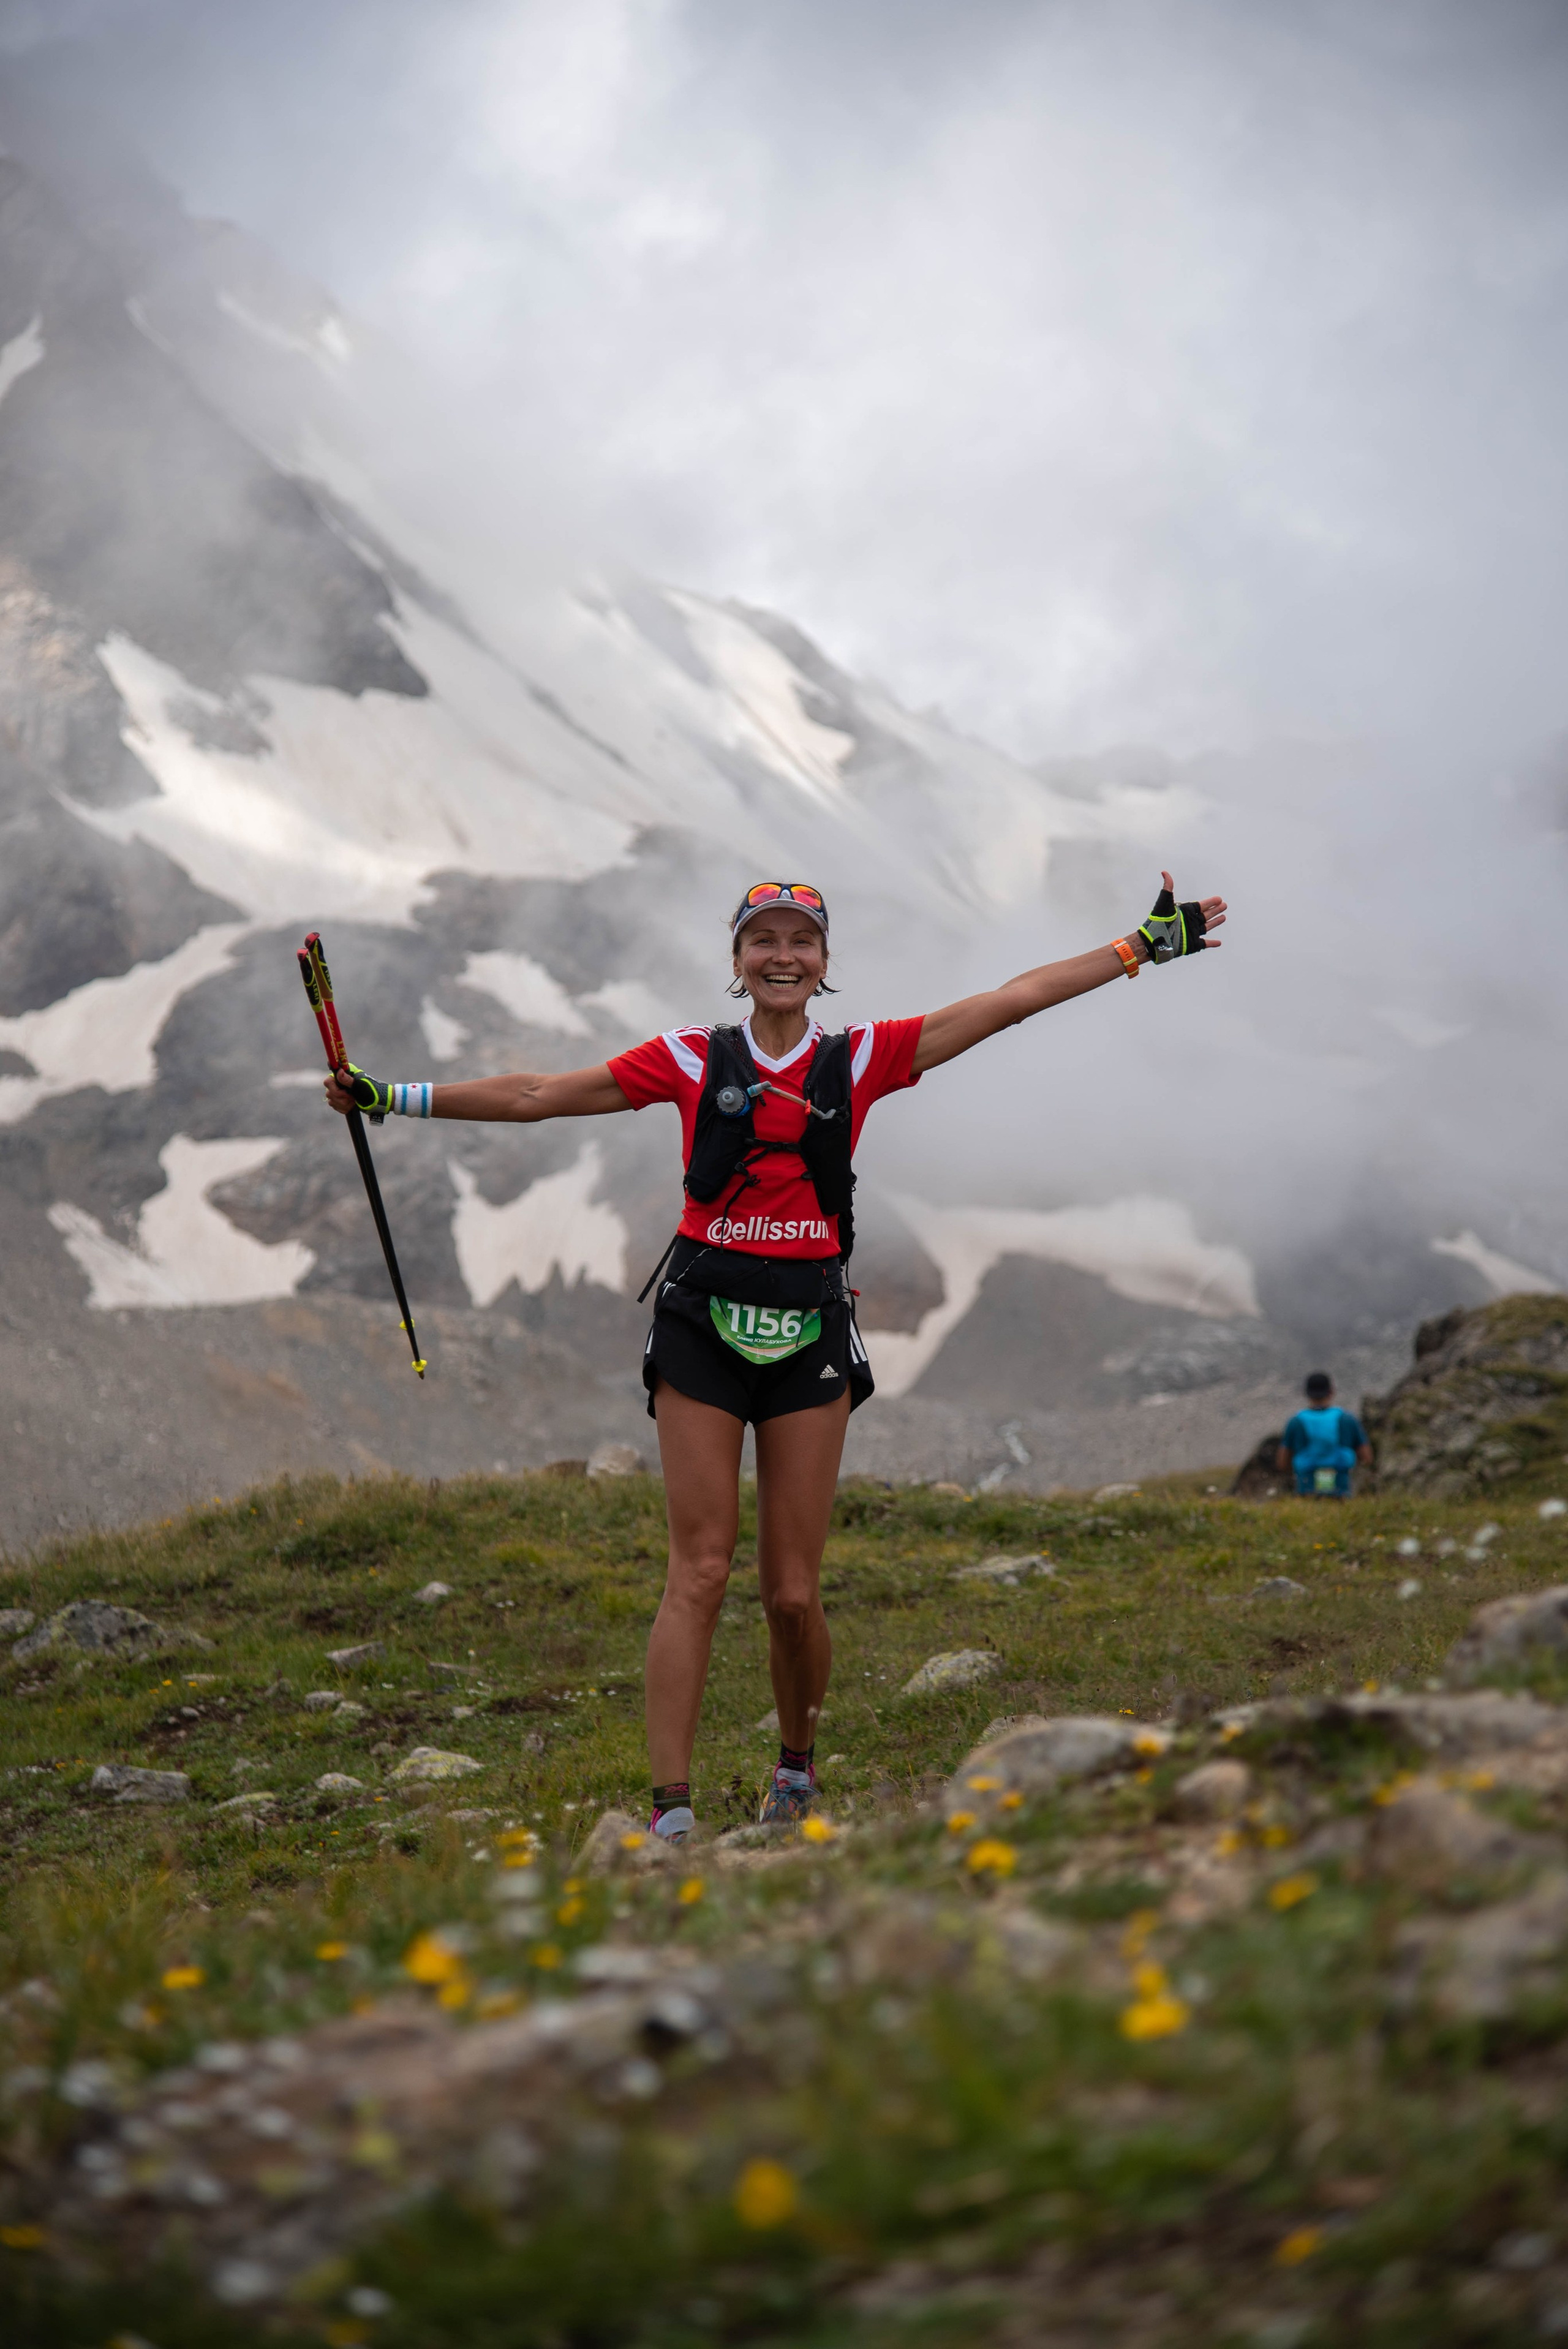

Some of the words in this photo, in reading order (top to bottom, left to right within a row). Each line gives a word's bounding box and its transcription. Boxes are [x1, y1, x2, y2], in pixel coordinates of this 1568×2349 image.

[337, 1041, 348, 1065] LEKI
[707, 1216, 829, 1244] @ellissrun
[727, 1303, 802, 1338] 1156
